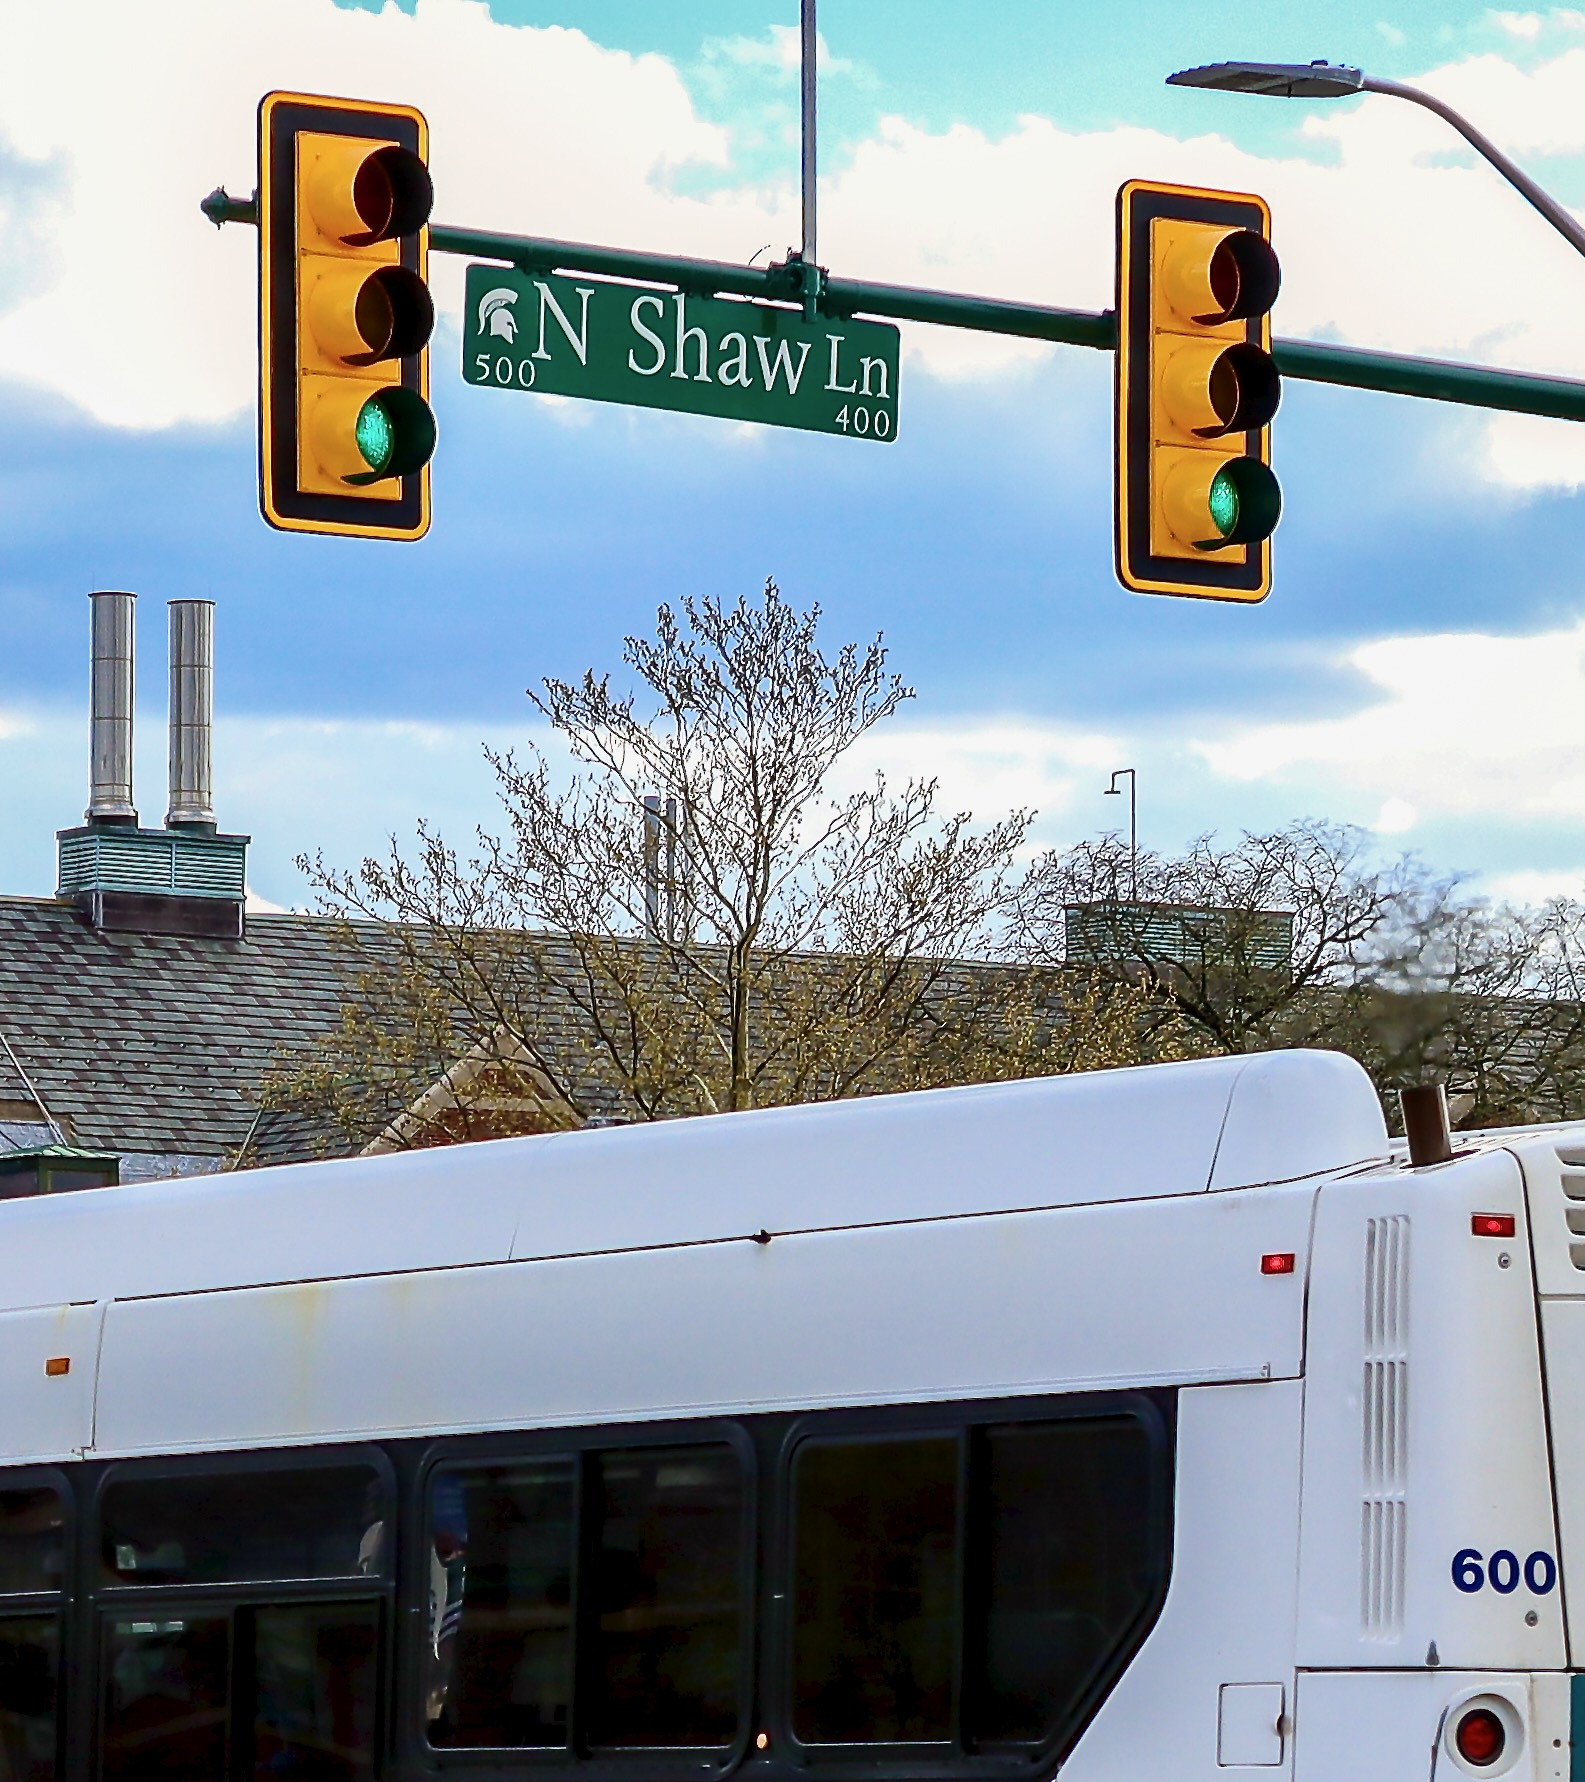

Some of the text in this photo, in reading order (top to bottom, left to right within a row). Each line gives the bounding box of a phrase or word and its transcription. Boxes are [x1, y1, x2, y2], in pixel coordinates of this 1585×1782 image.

[531, 280, 891, 399] N Shaw Ln
[475, 353, 536, 388] 500
[834, 403, 891, 438] 400
[1449, 1548, 1557, 1595] 600
